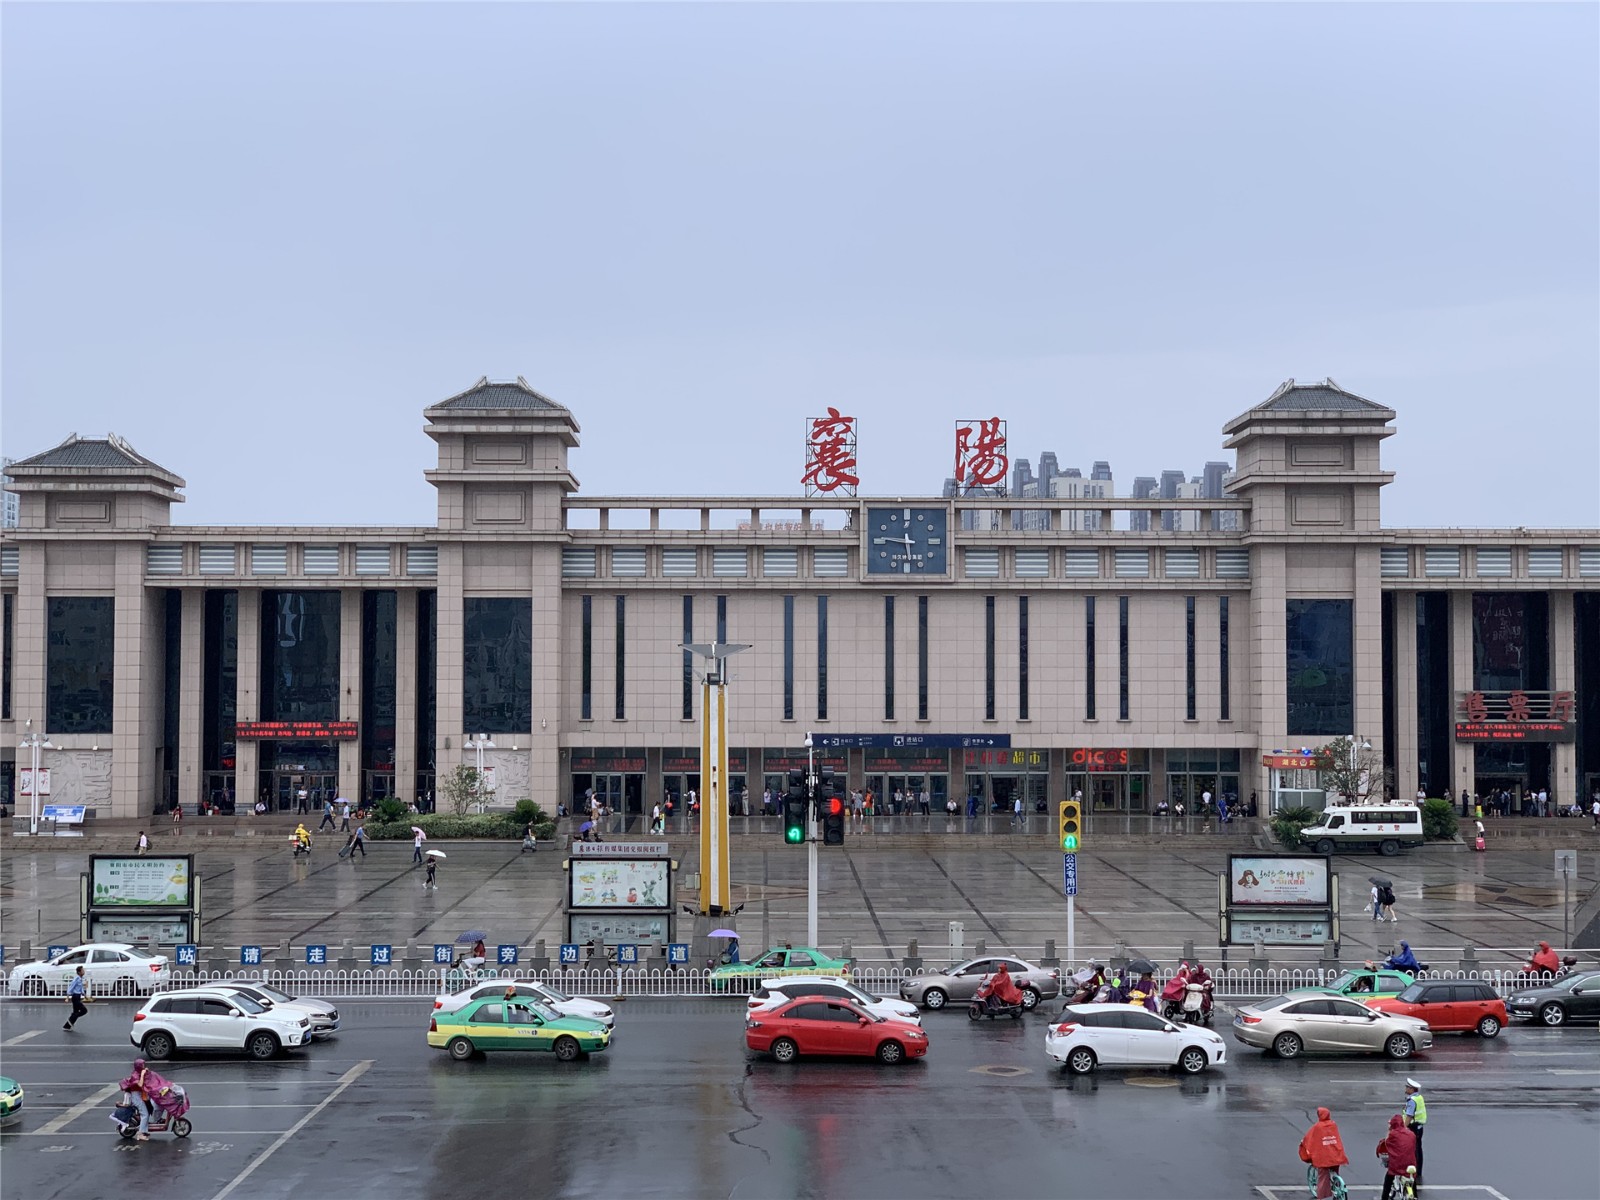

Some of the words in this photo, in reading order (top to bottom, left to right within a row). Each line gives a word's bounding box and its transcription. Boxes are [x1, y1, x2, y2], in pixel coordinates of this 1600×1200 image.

[1462, 690, 1573, 722] 售票厅
[1072, 747, 1128, 765] dicos
[1065, 854, 1076, 895] 公交专用灯
[179, 948, 195, 962] 站
[244, 948, 259, 963] 请
[309, 948, 324, 963] 走
[373, 948, 389, 962] 过
[436, 947, 452, 962] 街
[501, 947, 516, 962] 旁
[562, 947, 577, 961] 边
[620, 946, 636, 961] 通
[671, 946, 687, 961] 道
